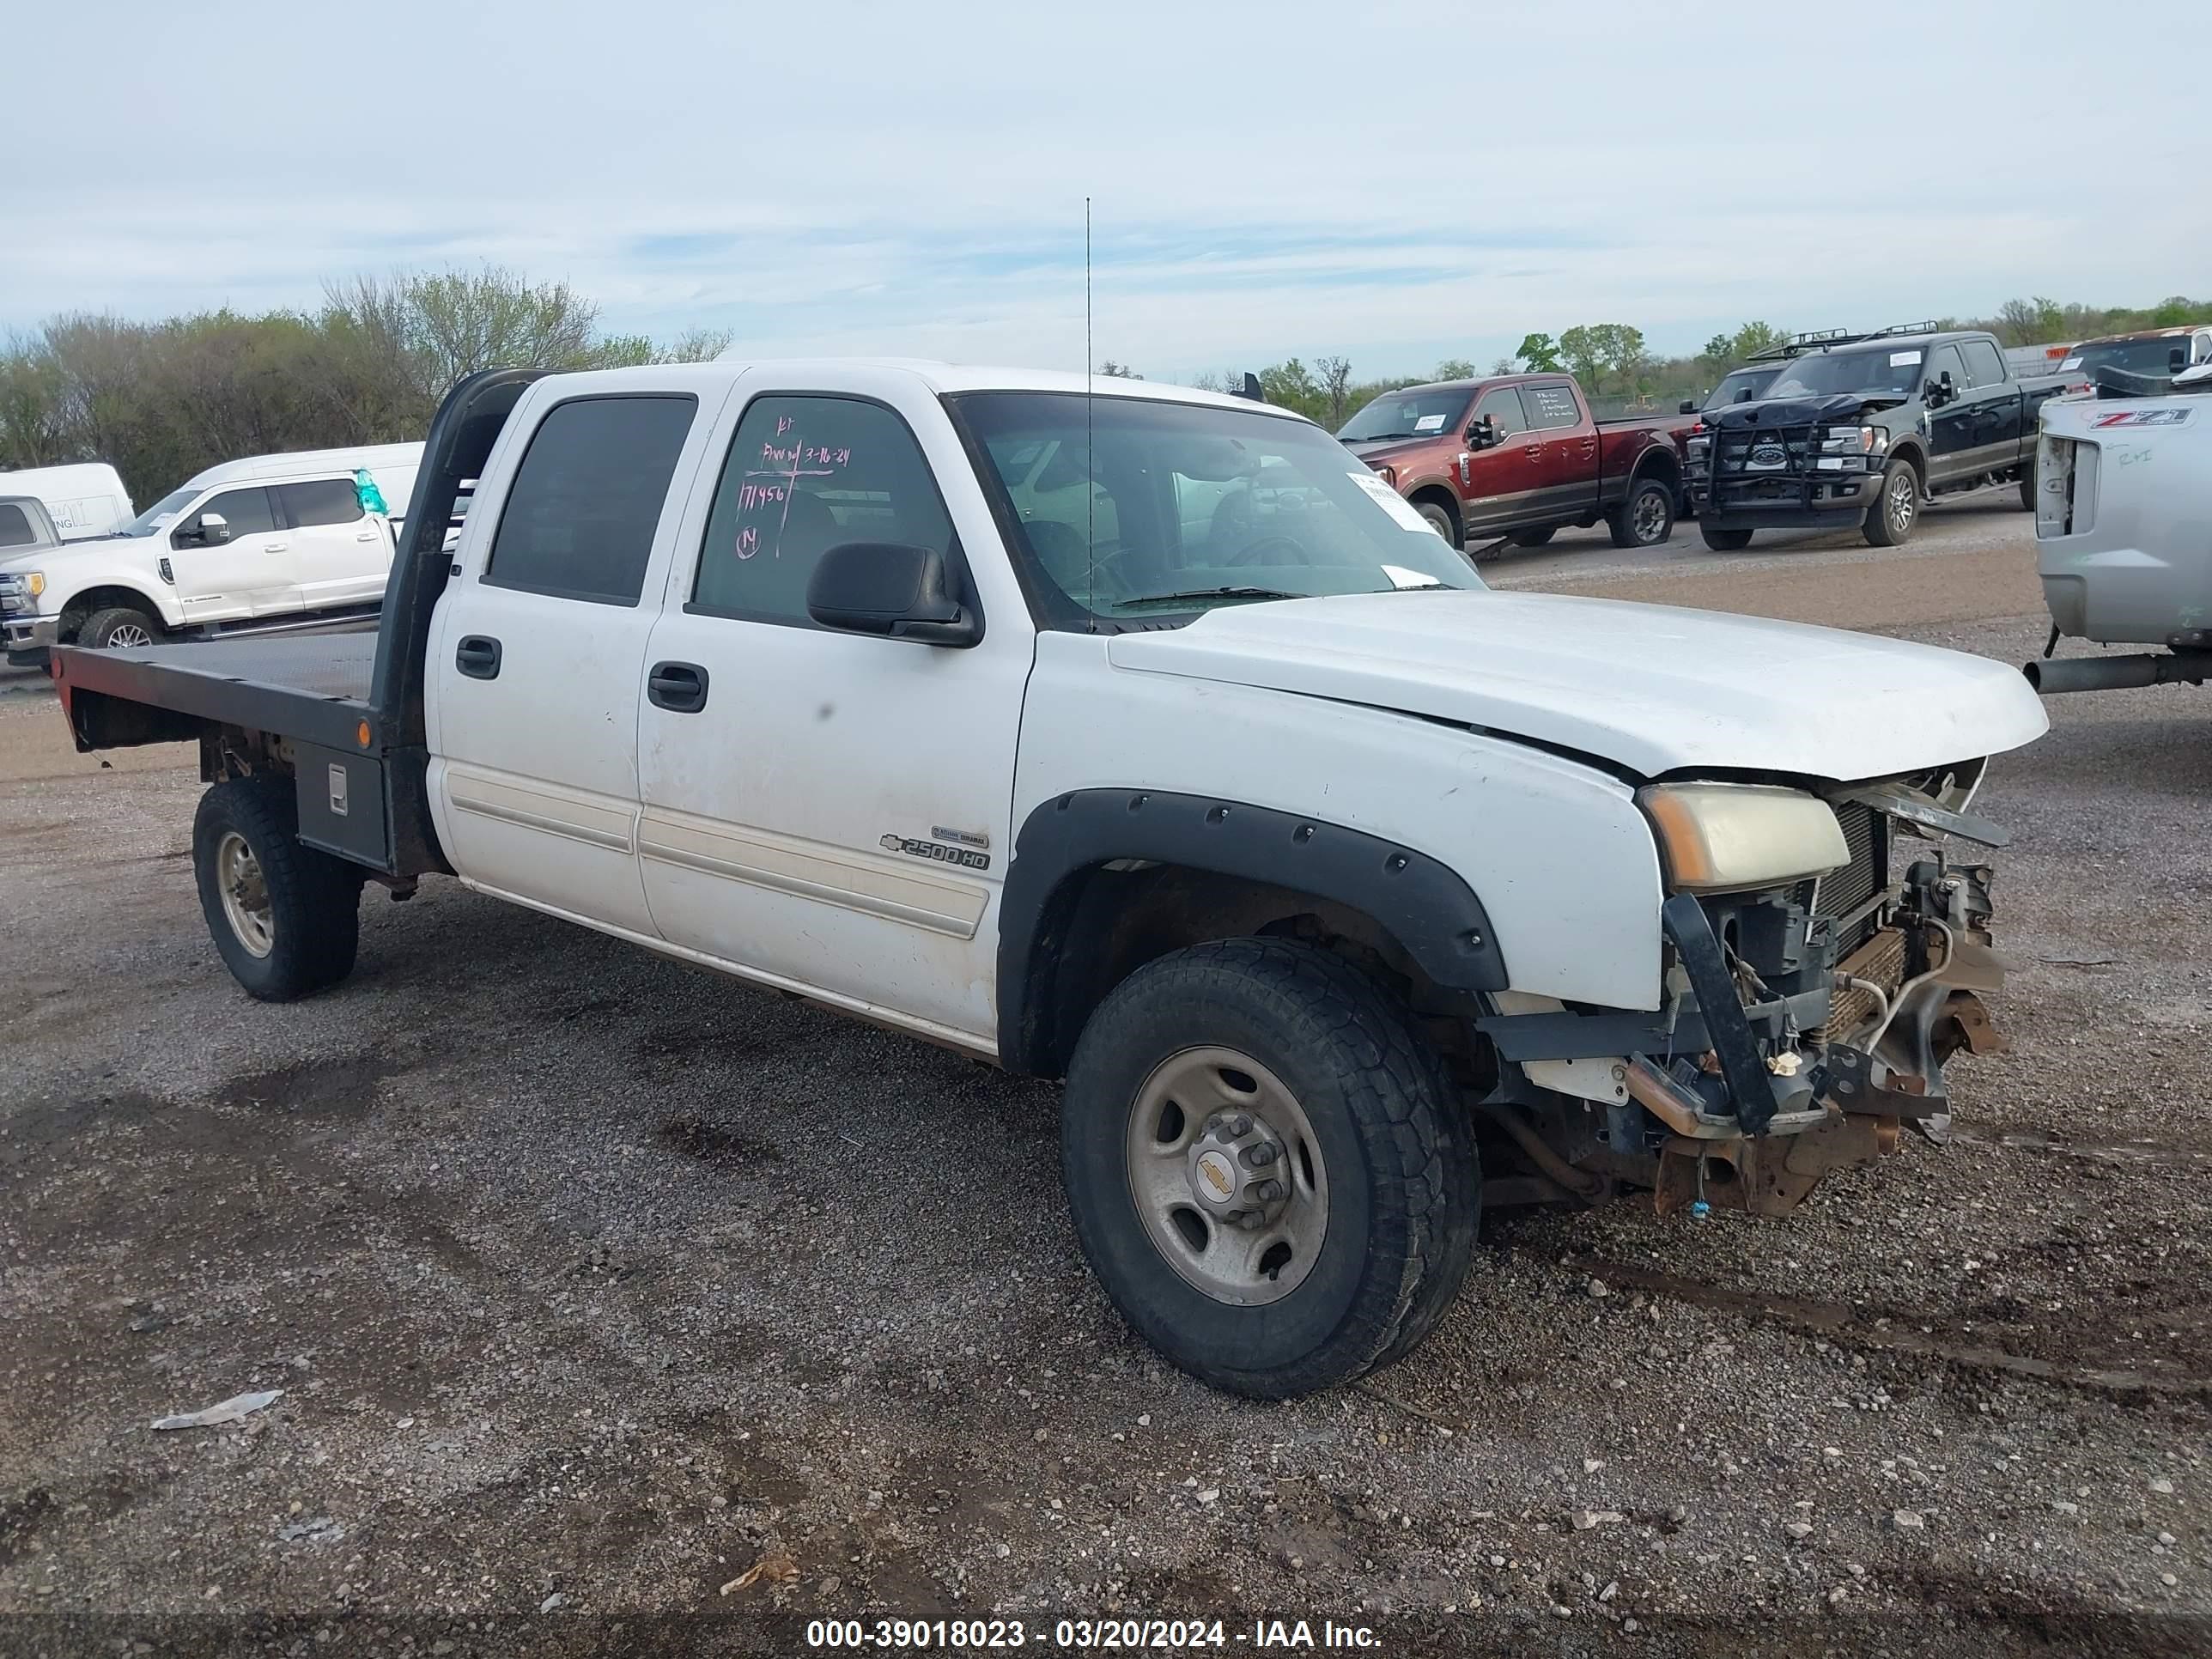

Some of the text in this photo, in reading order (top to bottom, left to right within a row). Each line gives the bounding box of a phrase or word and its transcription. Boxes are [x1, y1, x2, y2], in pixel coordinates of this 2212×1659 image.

[2090, 408, 2192, 429] Z71
[906, 839, 987, 867] 2500 HD
